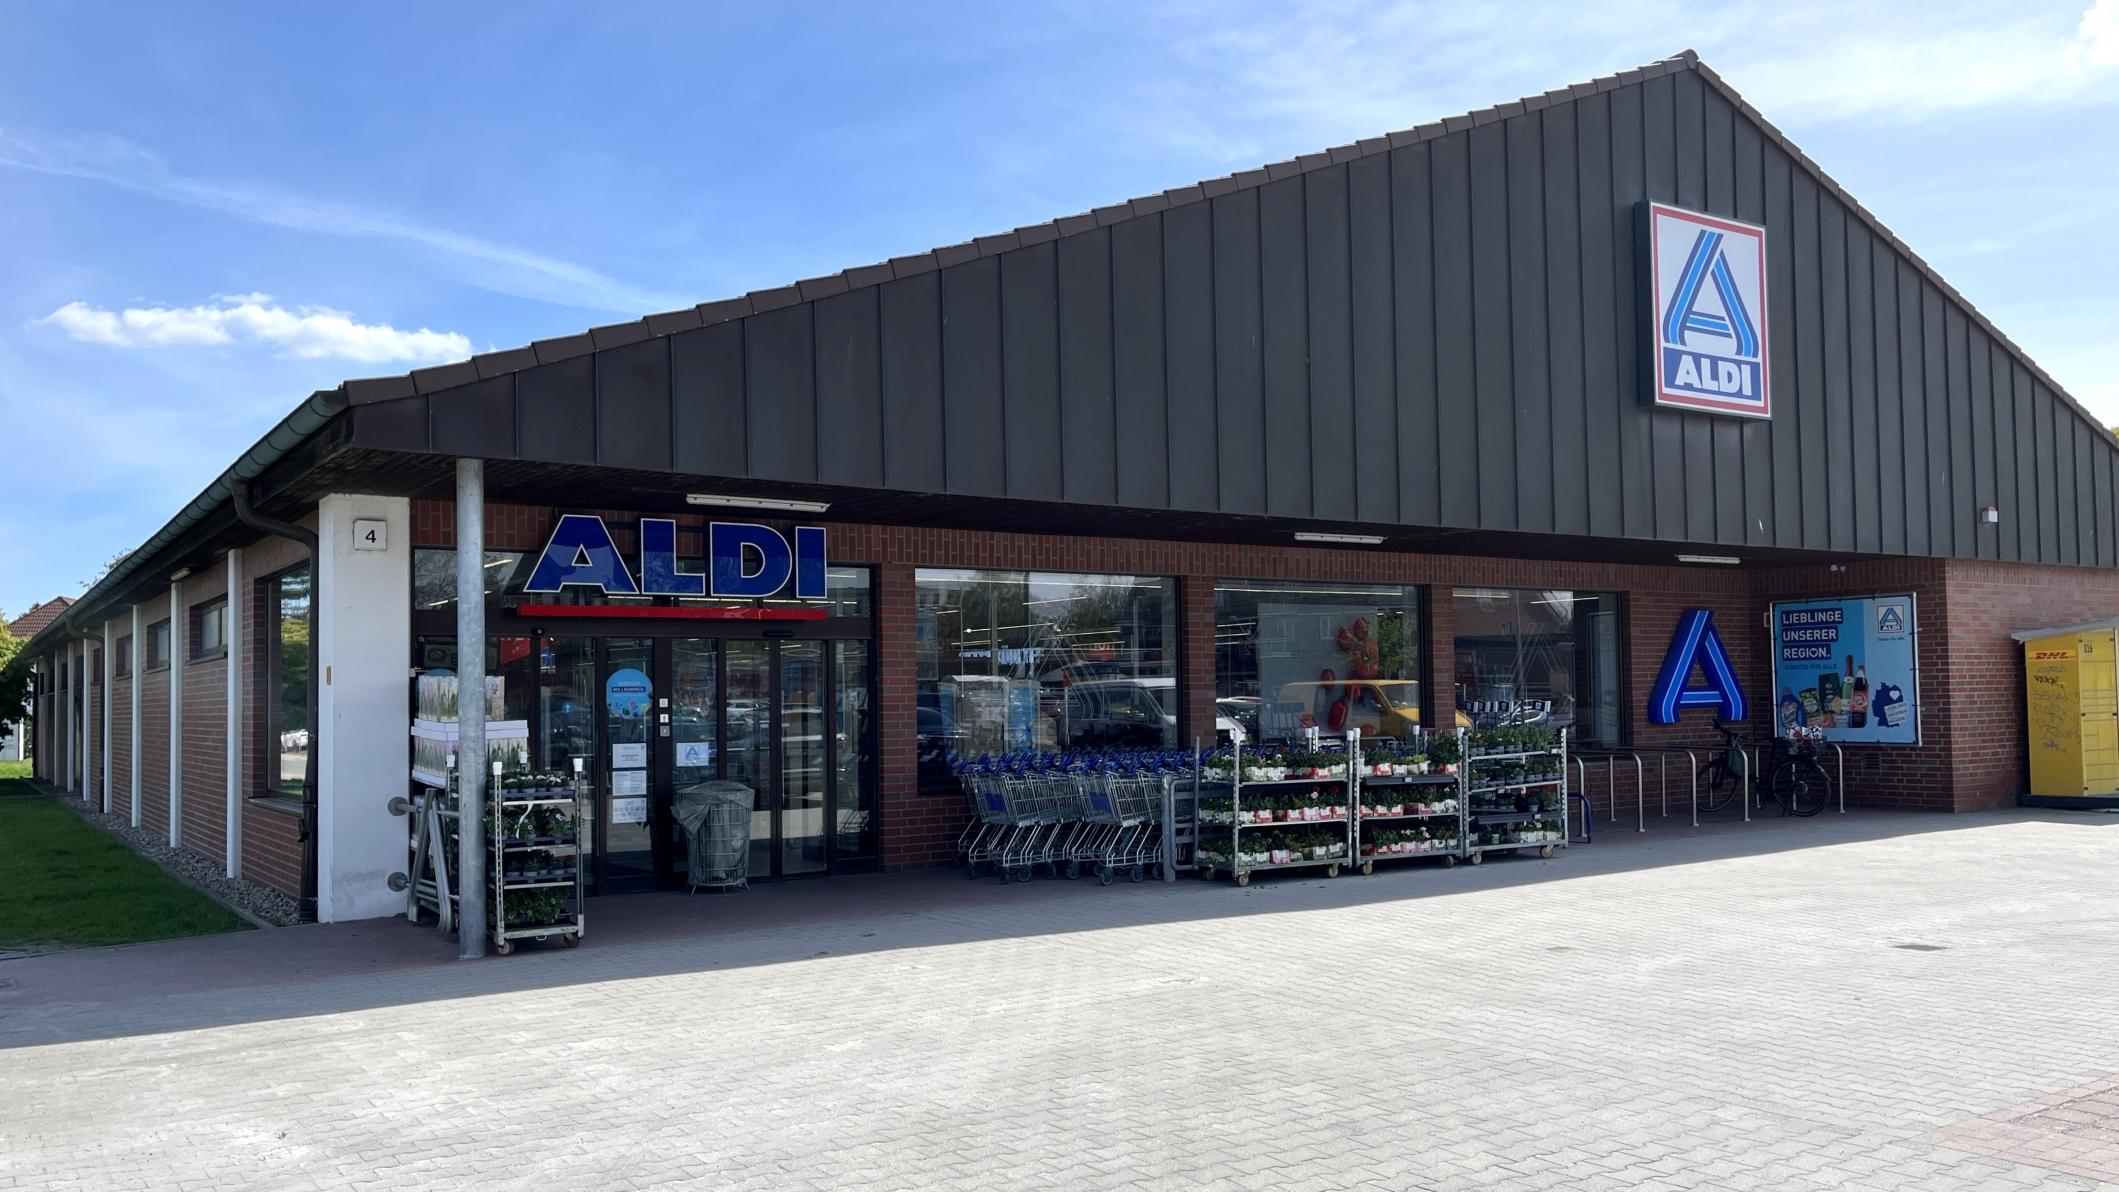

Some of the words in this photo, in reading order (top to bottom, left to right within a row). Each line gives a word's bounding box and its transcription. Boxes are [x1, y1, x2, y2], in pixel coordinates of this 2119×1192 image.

[1674, 354, 1753, 397] ALDI
[365, 529, 377, 543] 4
[523, 514, 828, 599] ALDI
[1782, 610, 1843, 624] LIEBLINGE
[1782, 629, 1837, 641] UNSERER
[1783, 647, 1831, 659] REGION.
[2034, 651, 2069, 660] DHL
